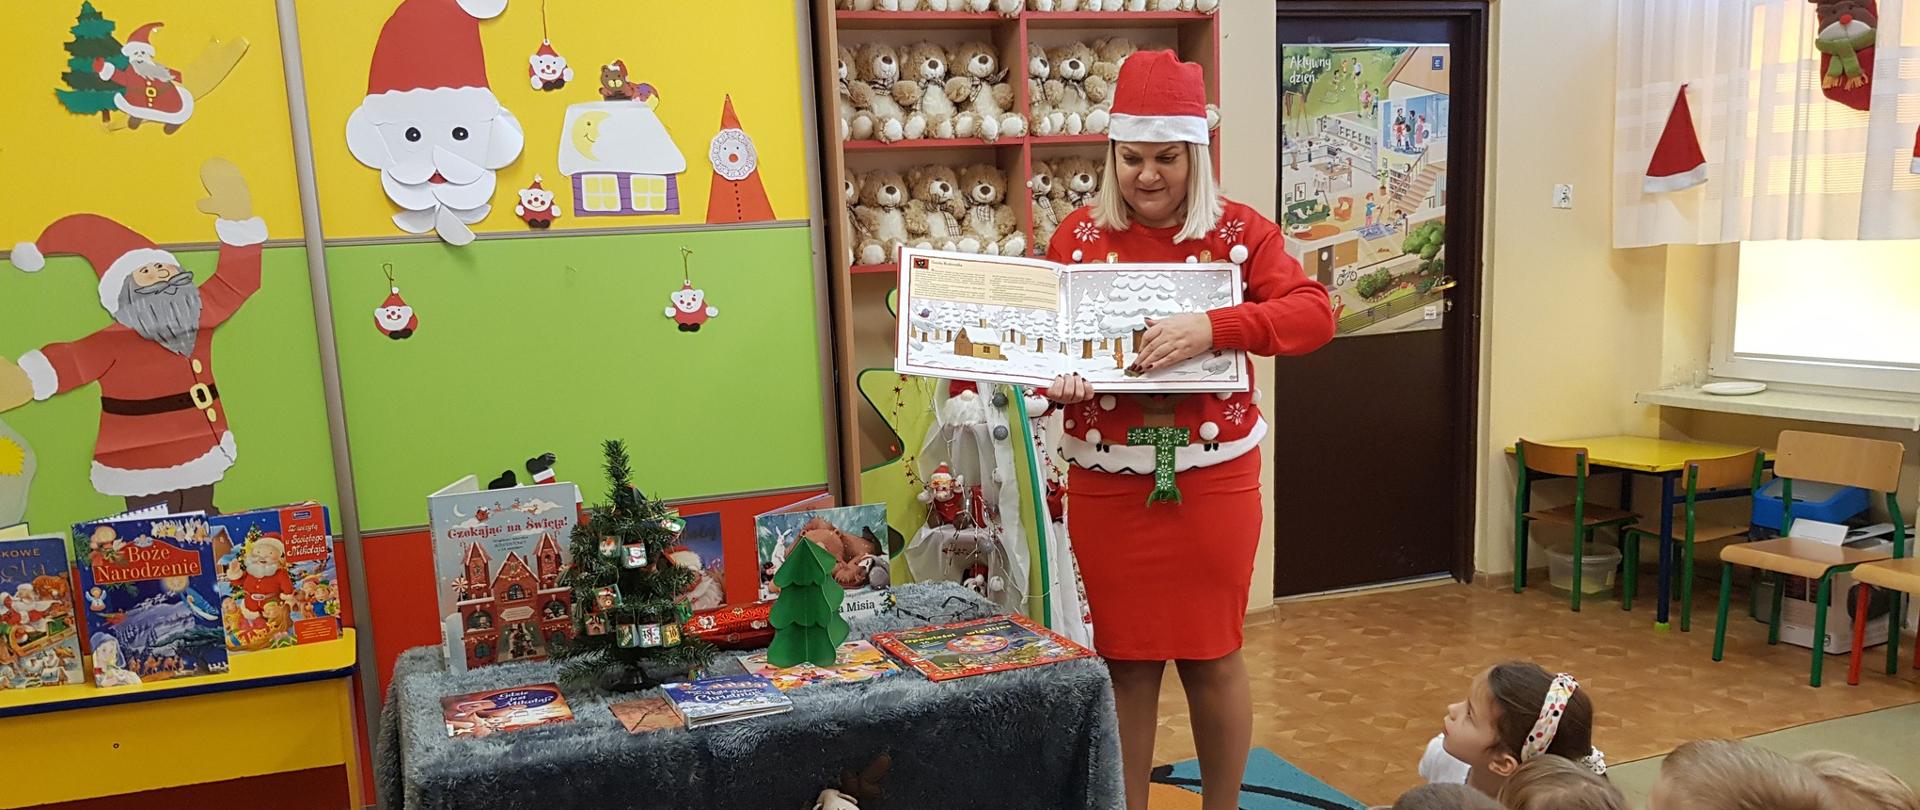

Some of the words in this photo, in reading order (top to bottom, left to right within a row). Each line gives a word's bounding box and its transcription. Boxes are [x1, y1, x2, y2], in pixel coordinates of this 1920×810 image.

[1290, 56, 1331, 71] Aktywny
[1290, 70, 1315, 85] dzień
[447, 525, 502, 539] Czekając
[507, 524, 521, 532] na
[526, 516, 568, 530] Święta!
[127, 545, 170, 562] Boże
[97, 559, 198, 582] Narodzenie
[846, 600, 875, 612] Misia
